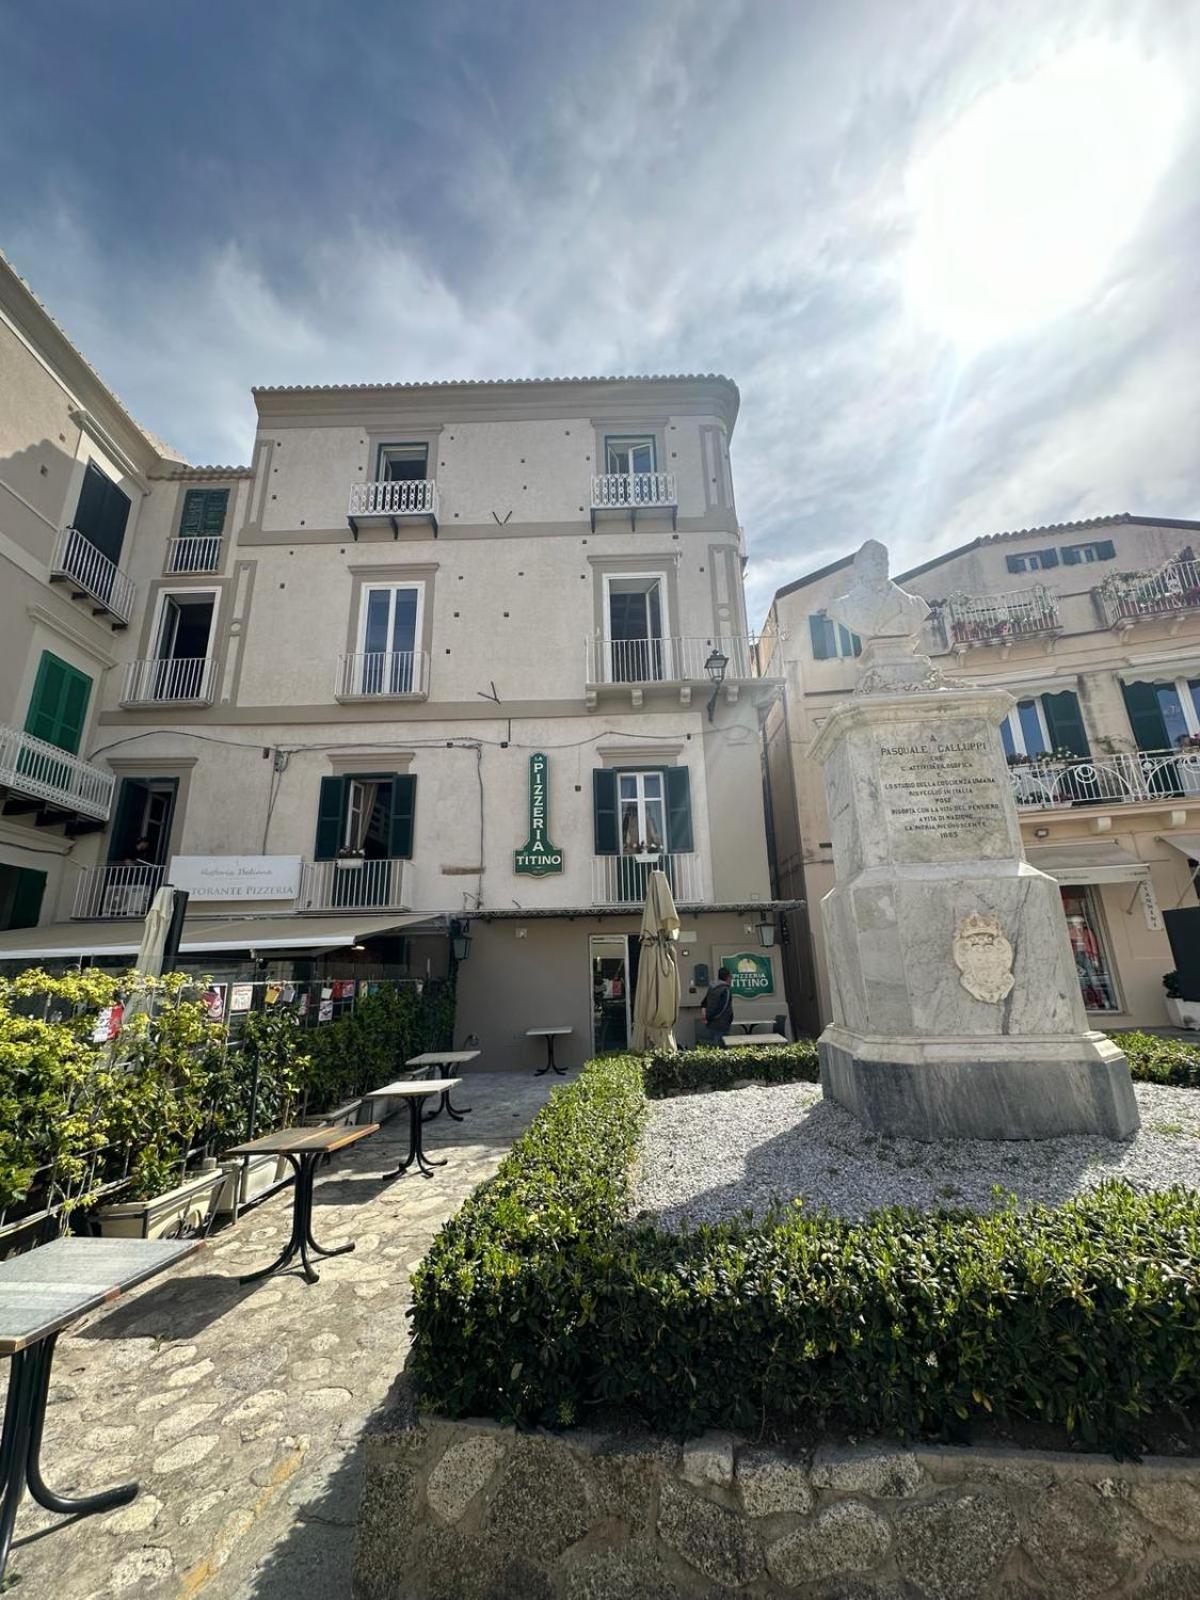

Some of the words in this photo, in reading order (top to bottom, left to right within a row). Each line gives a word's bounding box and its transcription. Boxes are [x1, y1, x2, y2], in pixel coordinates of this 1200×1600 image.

[880, 746, 928, 756] PASQUALE
[937, 743, 986, 752] GALLUPPI
[532, 763, 545, 851] PIZZERIA
[516, 855, 561, 865] TITINO
[246, 886, 293, 895] PIZZERIA
[731, 978, 769, 987] TITINO
